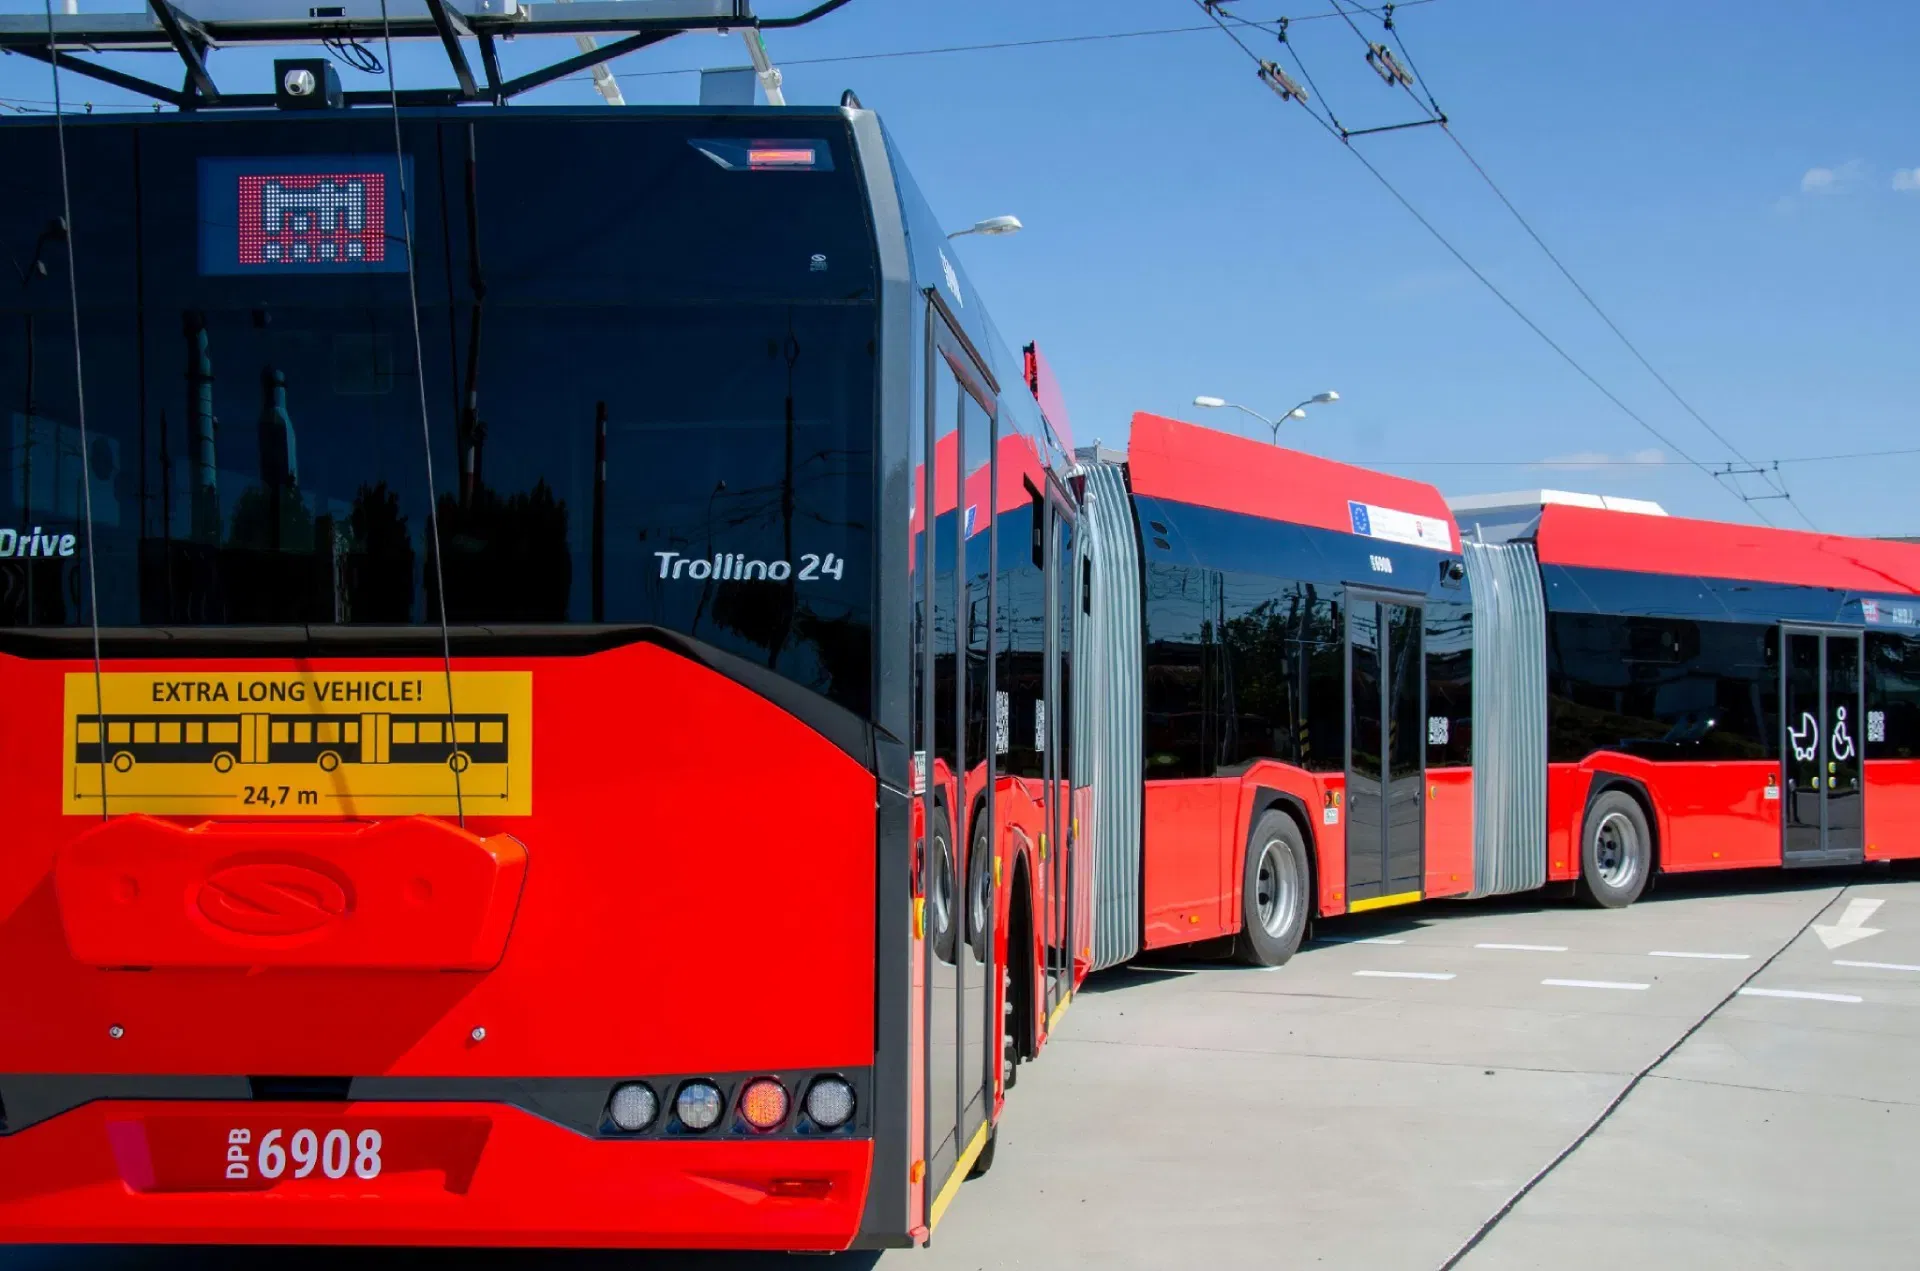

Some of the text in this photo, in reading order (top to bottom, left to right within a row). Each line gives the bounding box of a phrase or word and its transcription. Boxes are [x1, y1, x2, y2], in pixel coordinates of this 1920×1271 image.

[0, 526, 76, 557] Drive
[653, 551, 844, 581] Trollino 24
[151, 680, 424, 702] EXTRA LONG VEHICLE!
[242, 786, 319, 808] 24,7 m
[226, 1128, 251, 1179] DPB
[258, 1128, 383, 1179] 6908
